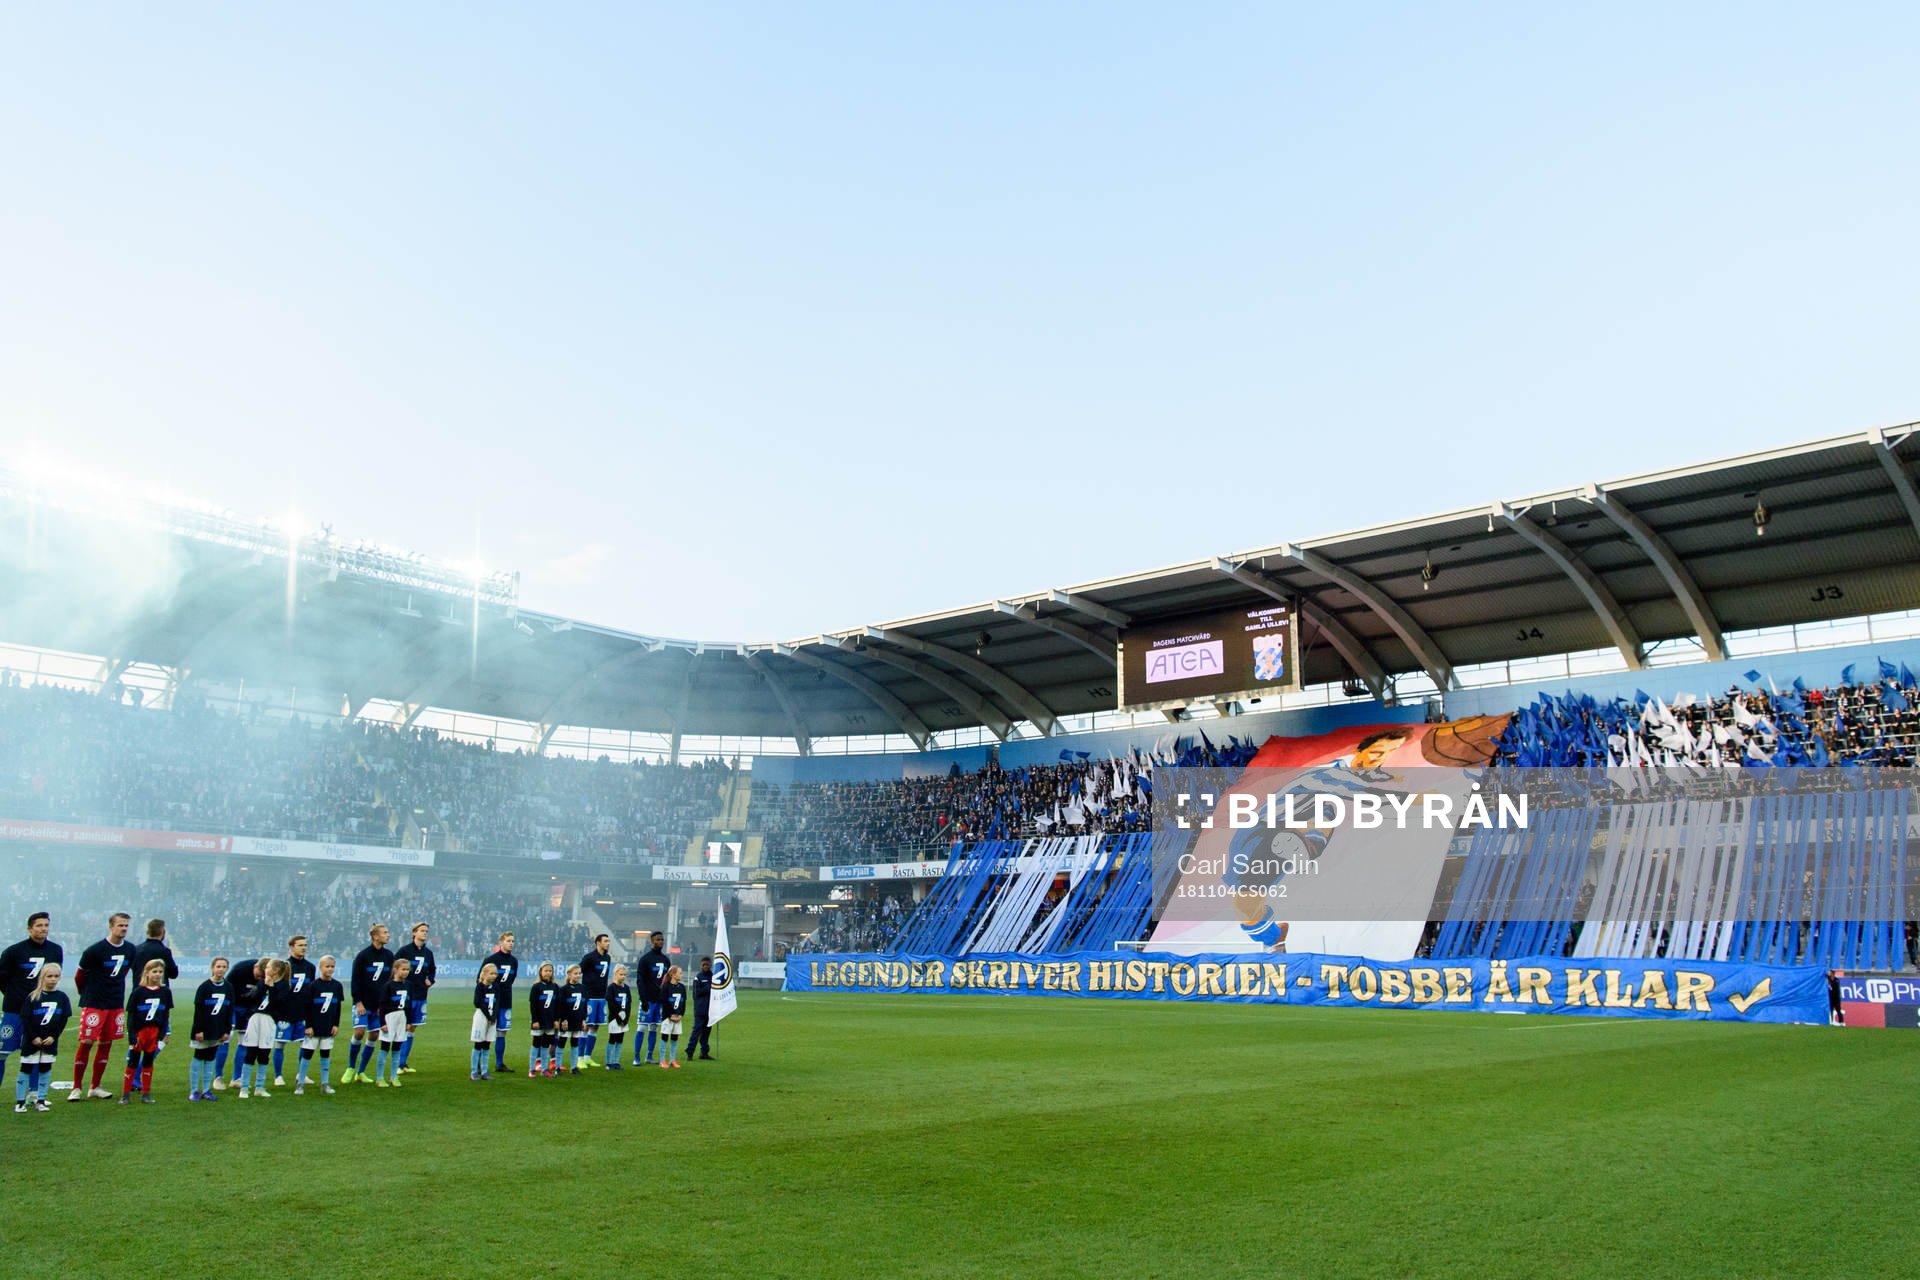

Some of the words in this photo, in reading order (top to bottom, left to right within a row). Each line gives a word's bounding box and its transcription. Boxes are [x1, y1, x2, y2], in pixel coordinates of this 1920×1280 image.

[1811, 586, 1844, 602] J3
[1267, 620, 1289, 628] ULLEVI
[1153, 639, 1176, 648] DAGENS
[1517, 627, 1545, 642] J4
[1151, 648, 1217, 677] ATEA
[1088, 687, 1112, 698] H3
[663, 871, 691, 880] RASTA
[701, 871, 729, 881] RASTA
[892, 868, 915, 877] RASTA
[922, 867, 945, 876] RASTA
[26, 957, 45, 979] 7
[110, 955, 125, 977] 7
[372, 962, 385, 981] 7
[414, 956, 425, 975] 7
[500, 965, 512, 983] 7
[600, 961, 609, 978] 7
[655, 962, 665, 979] 7
[293, 973, 306, 993] 7
[810, 960, 945, 988] LEGENDER
[951, 960, 1081, 991] SKRIVER
[1088, 960, 1287, 996] HISTORIEN
[1321, 964, 1473, 1003] TOBBE
[1483, 959, 1554, 1006] ÄR
[1565, 967, 1716, 1012] KLAR
[211, 993, 226, 1016] 7
[320, 992, 334, 1014] 7
[396, 990, 408, 1009] 7
[543, 990, 554, 1009] 7
[572, 993, 582, 1011] 7
[618, 993, 627, 1009] 7
[672, 993, 681, 1010] 7
[40, 1002, 58, 1026] 7
[145, 998, 160, 1021] 7
